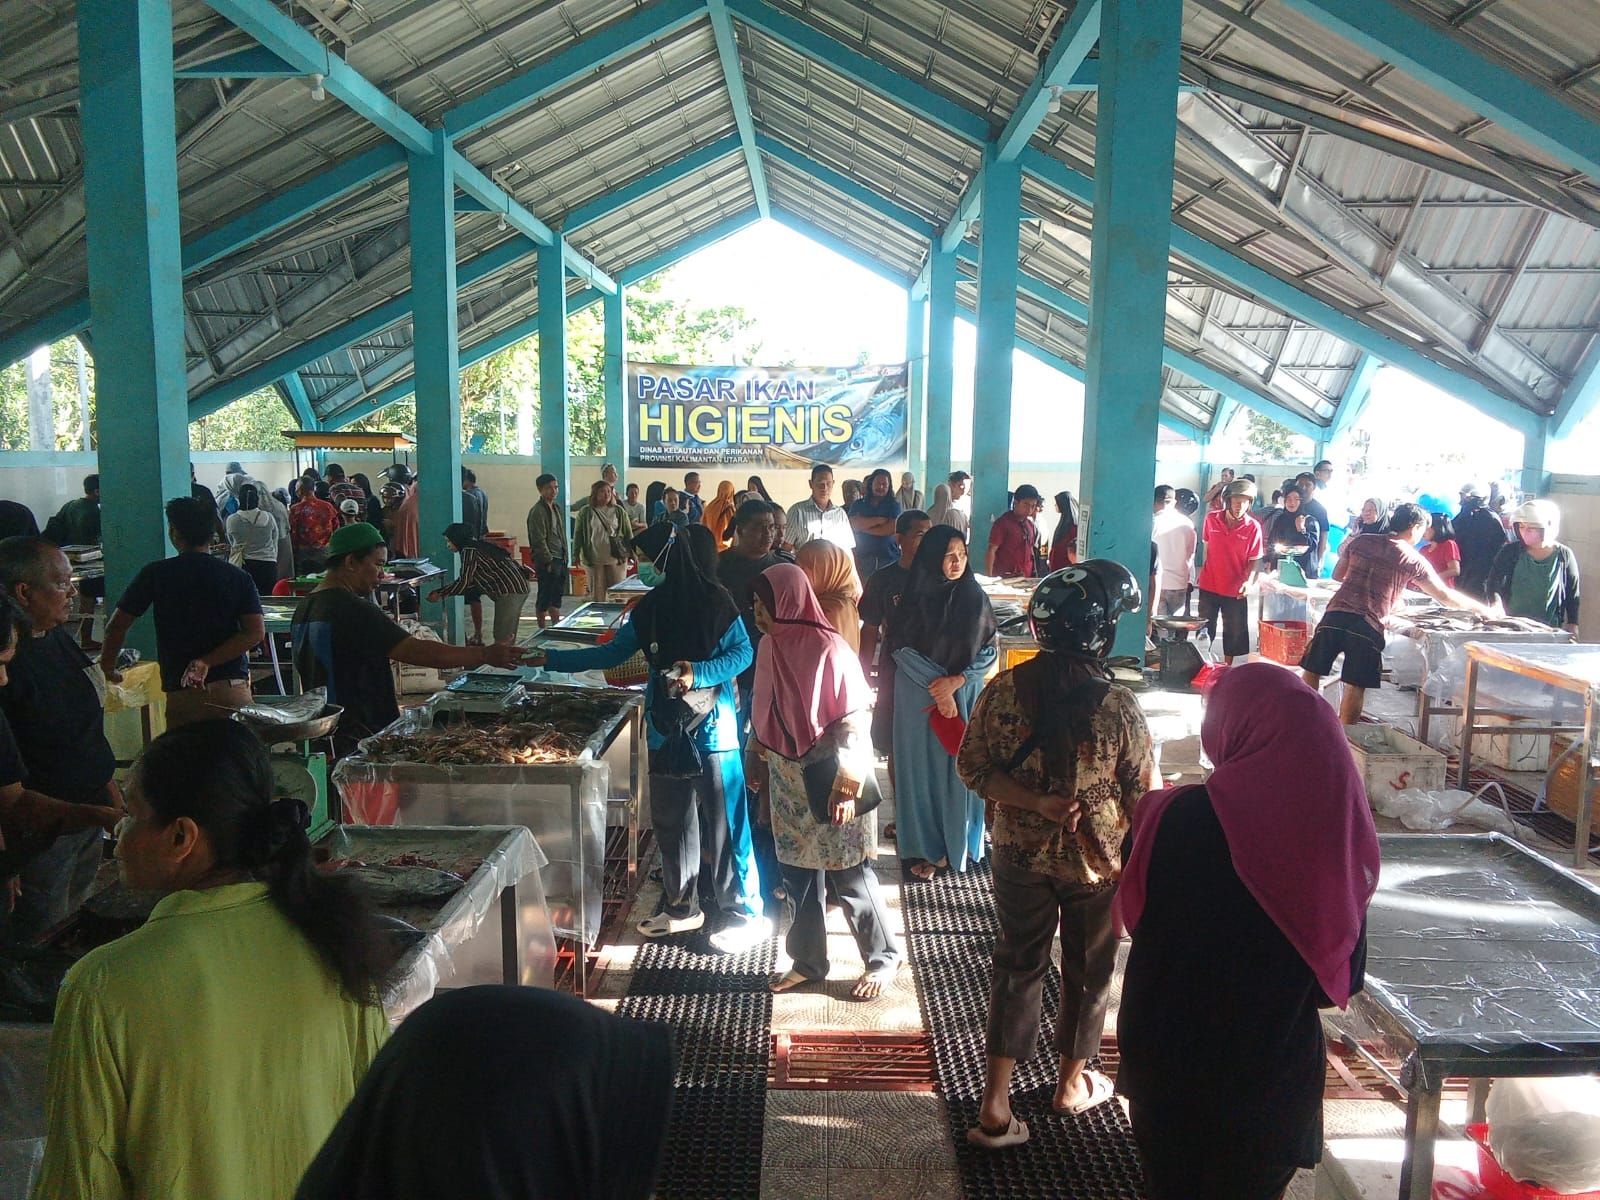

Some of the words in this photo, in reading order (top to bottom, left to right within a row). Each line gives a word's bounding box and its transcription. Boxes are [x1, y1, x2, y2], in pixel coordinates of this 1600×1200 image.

[638, 375, 736, 400] PASAR
[745, 379, 815, 401] IKAN
[638, 404, 854, 444] HIGIENIS
[639, 446, 662, 454] DINAS
[664, 446, 702, 455] KELAUTAN
[721, 448, 763, 456] PERIKANAN
[639, 454, 675, 463] PROVINSI
[675, 455, 722, 464] KALIMANTAN
[723, 456, 749, 464] UTARA
